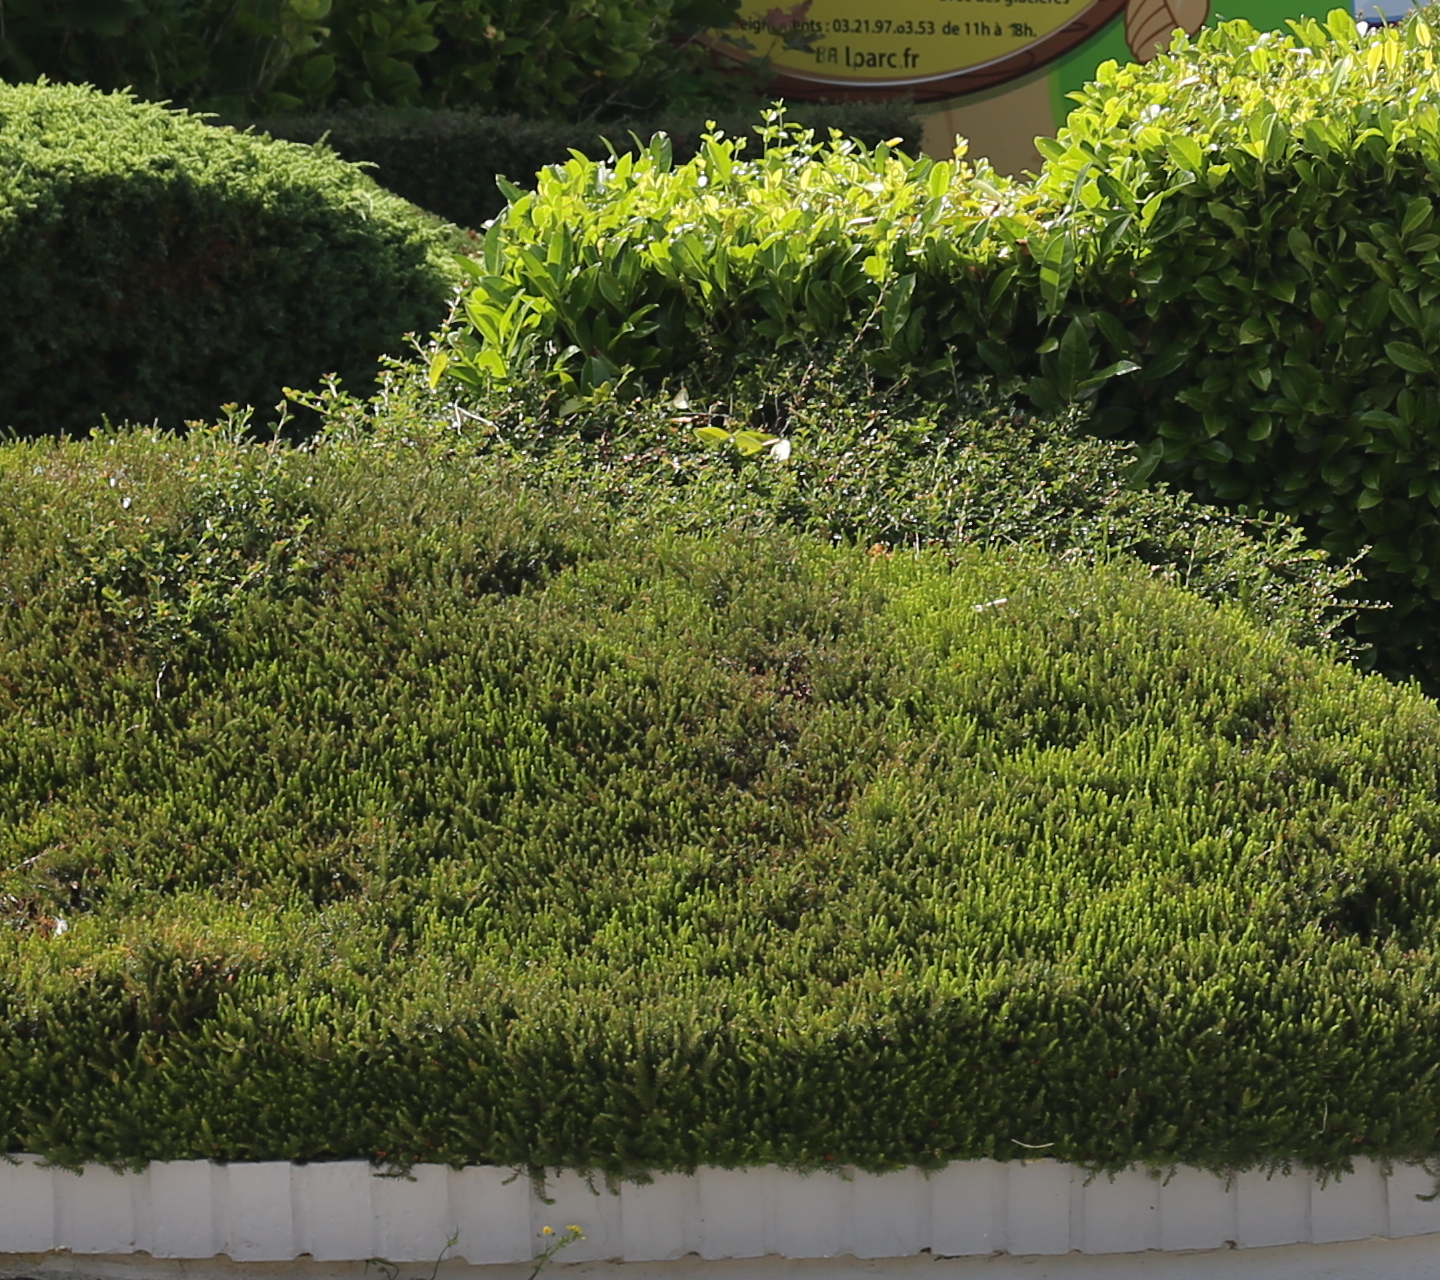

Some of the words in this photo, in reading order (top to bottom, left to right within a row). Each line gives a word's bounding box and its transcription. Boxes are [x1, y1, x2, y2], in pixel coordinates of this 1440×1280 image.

[942, 21, 960, 35] de
[964, 22, 990, 36] 11h
[993, 22, 1002, 36] à
